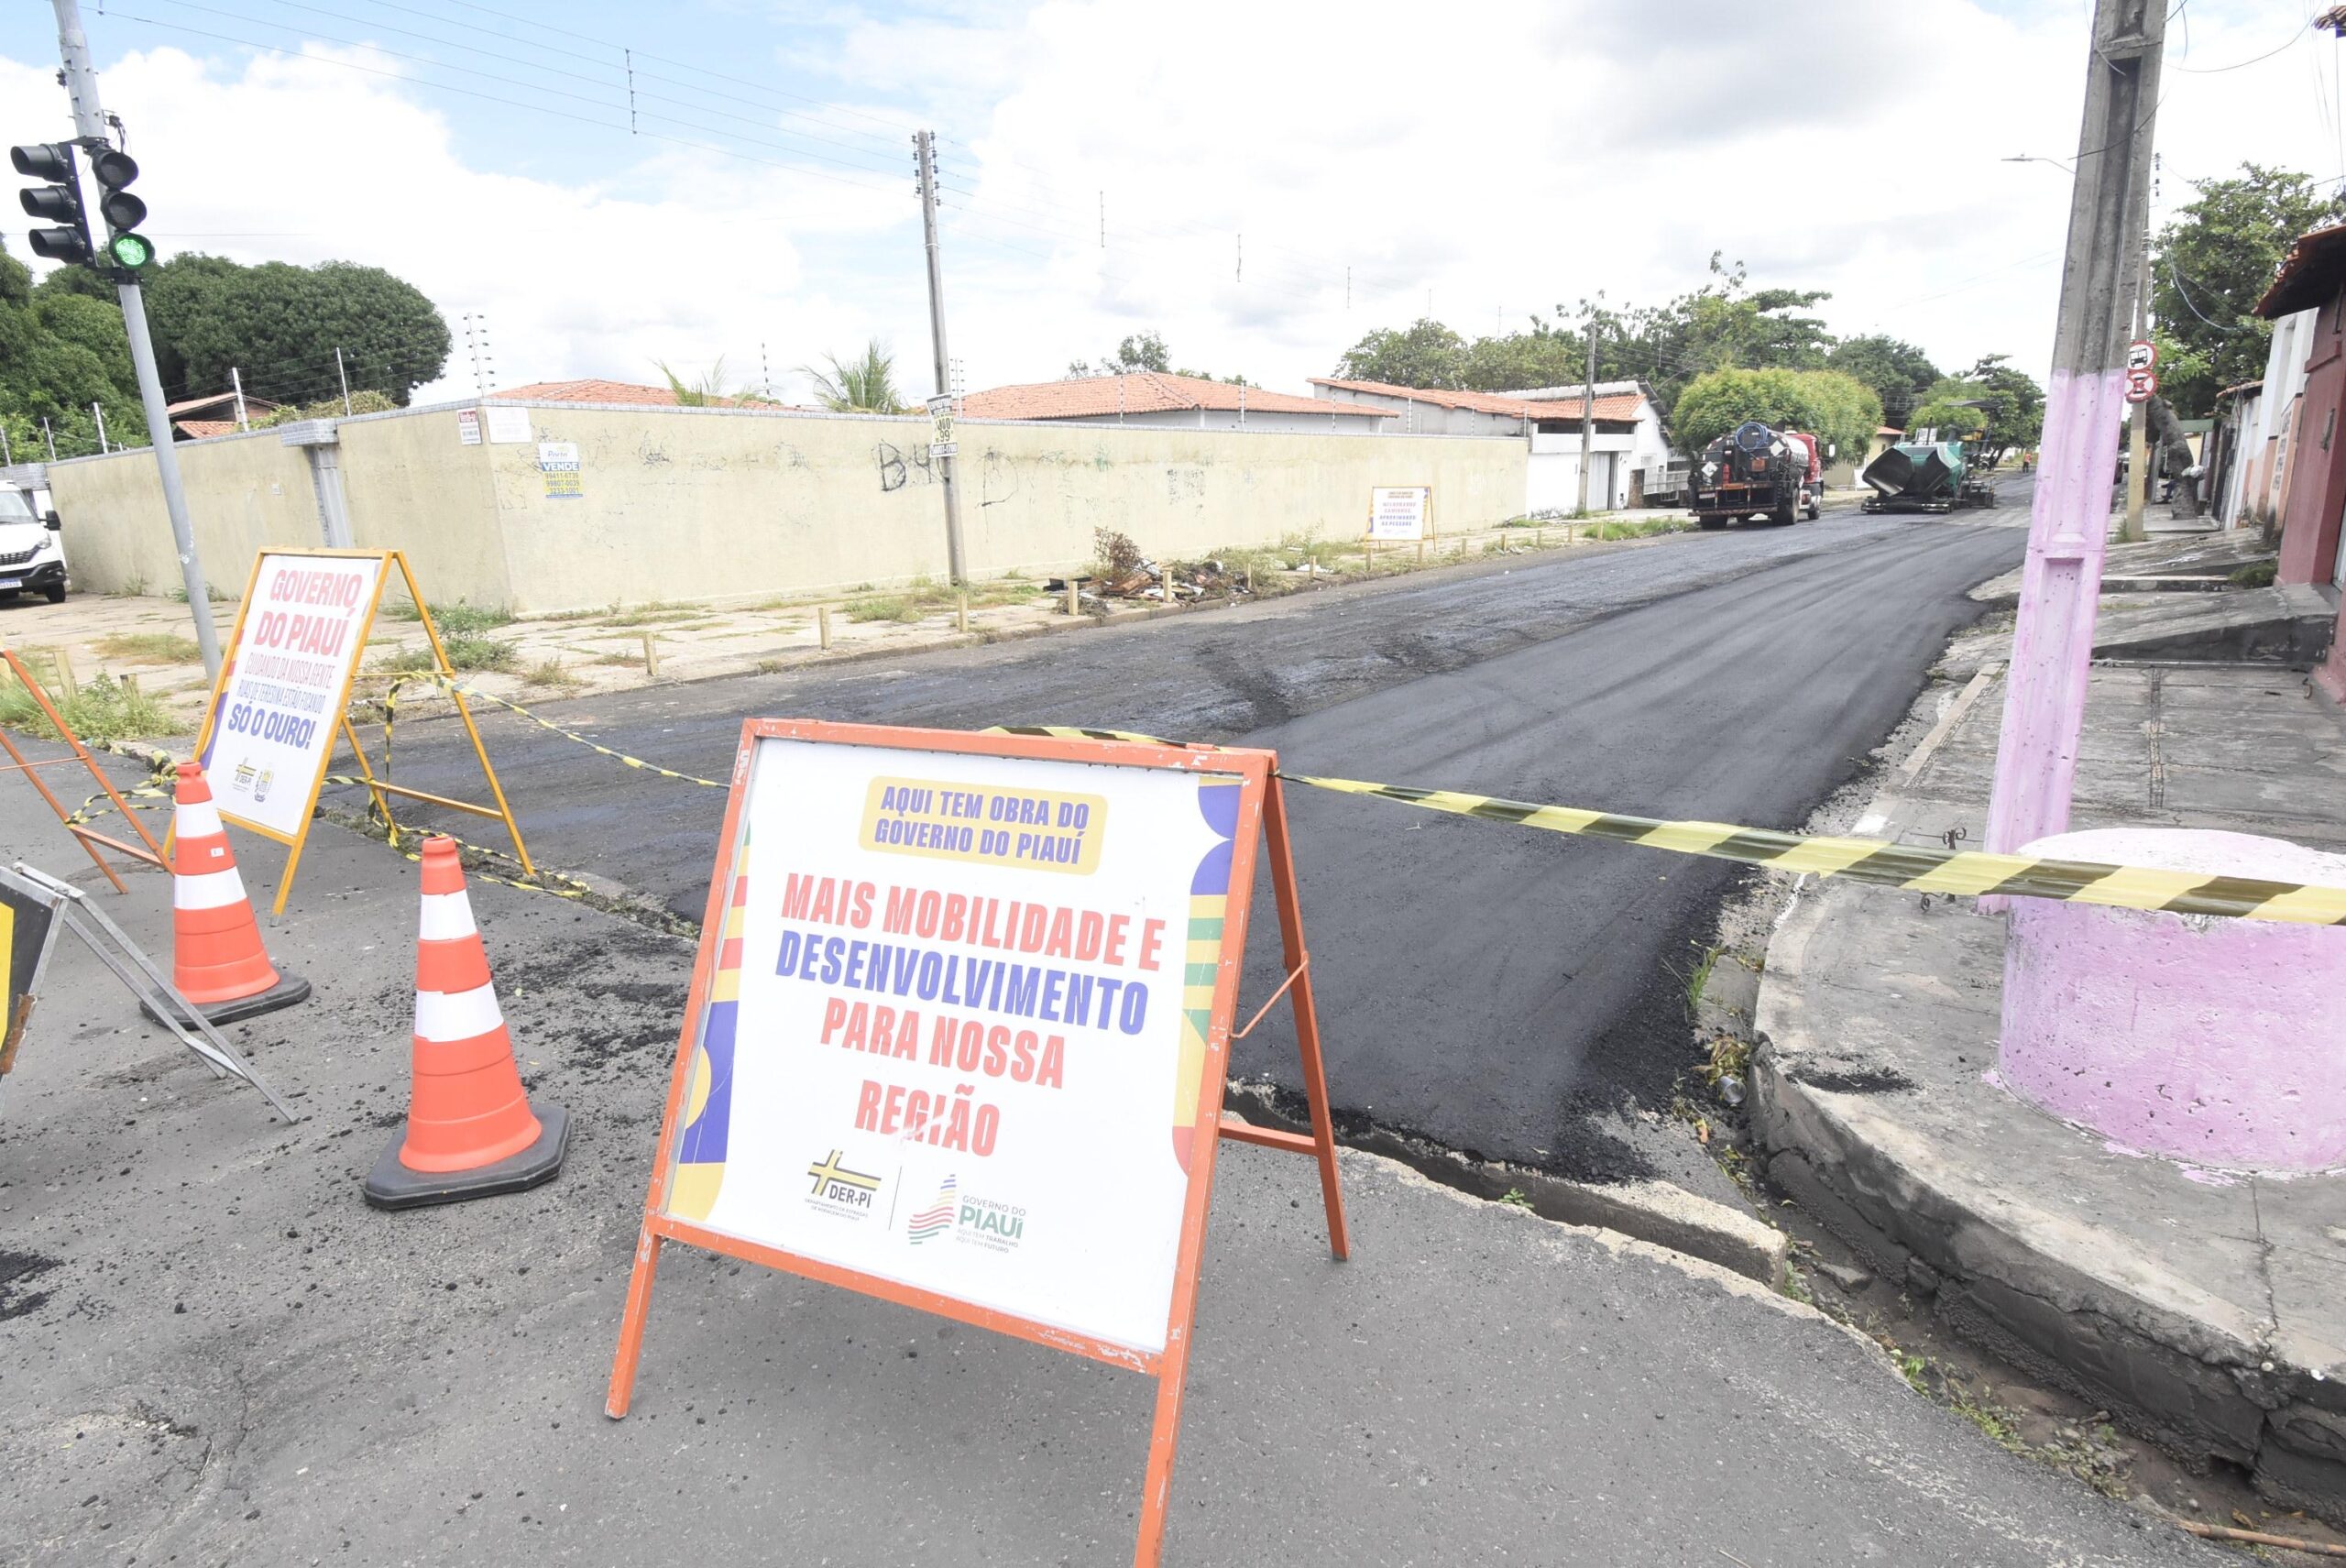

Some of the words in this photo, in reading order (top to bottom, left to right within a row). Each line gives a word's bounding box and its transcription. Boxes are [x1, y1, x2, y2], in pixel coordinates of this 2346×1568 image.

[543, 462, 578, 471] VENDE
[269, 569, 363, 609] GOVERNO
[254, 611, 288, 647] DO
[284, 609, 356, 657] PIAUÍ
[245, 652, 280, 678] CUIDANDO
[276, 657, 290, 680] DA
[286, 659, 312, 685] NOSSA
[309, 663, 335, 689] GENTE
[227, 701, 252, 733] SÓ
[250, 708, 266, 736] O
[264, 711, 317, 750] OURO!
[881, 786, 931, 814] AQUI
[939, 791, 982, 819] TEM
[990, 795, 1050, 826] OBRA
[1057, 801, 1090, 829] DO
[874, 818, 972, 853] GOVERNO
[979, 828, 1011, 858] DO
[1016, 831, 1085, 865] PIAUÍ
[781, 872, 876, 929] MAIS
[882, 885, 1131, 968] MOBILIDADE
[1138, 918, 1167, 971] E
[774, 930, 1149, 1036] DESENVOLVIMENTO
[820, 997, 917, 1061] PARA
[928, 1015, 1066, 1089] NOSSA
[854, 1080, 1001, 1157] REGIÃO
[828, 1184, 872, 1208] DER-PI
[962, 1195, 1009, 1212] GOVERNO
[1012, 1206, 1026, 1216] DO
[959, 1204, 1024, 1239] PIAUÍ
[986, 1234, 1019, 1248] TRABALHO
[984, 1242, 1010, 1254] FUTURO
